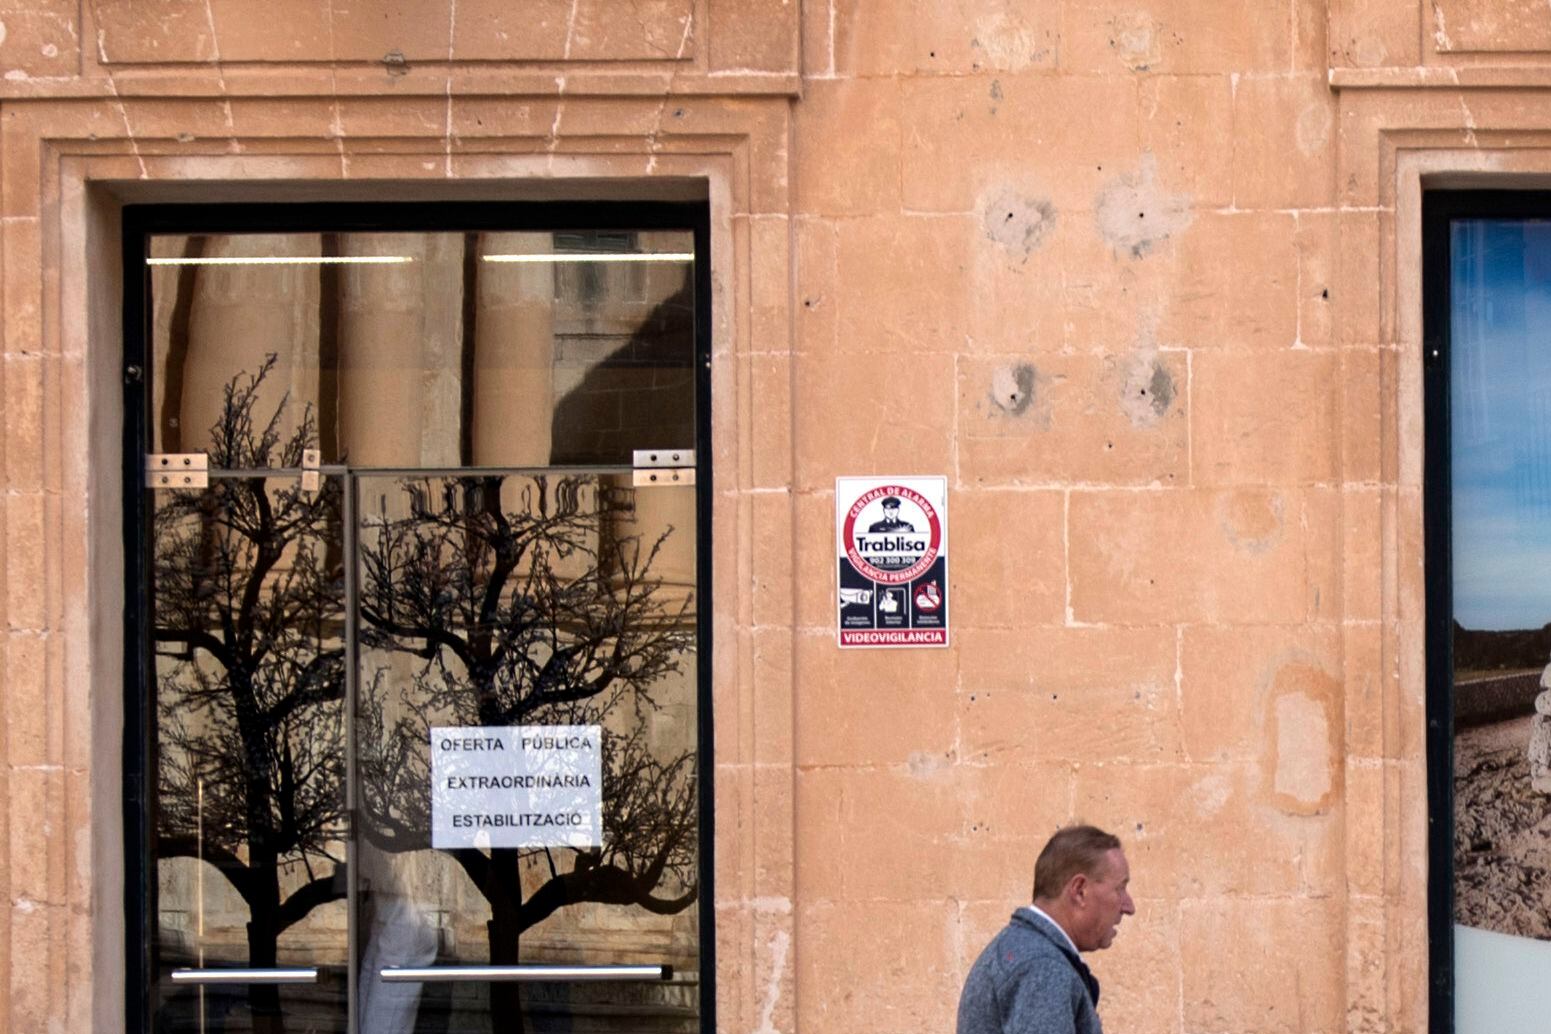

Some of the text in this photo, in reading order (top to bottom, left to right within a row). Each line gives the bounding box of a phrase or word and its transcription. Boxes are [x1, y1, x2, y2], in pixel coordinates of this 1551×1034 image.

[849, 487, 934, 518] CENTRAL DE ALARMA
[856, 536, 925, 552] Trablisa
[848, 547, 936, 581] VIGILANCIA PERMANENTE
[844, 632, 943, 643] VIDEOVIGILANCIA
[441, 734, 592, 751] OFERTA PÚBLICA
[453, 813, 582, 828] ESTABILITZACIÓ
